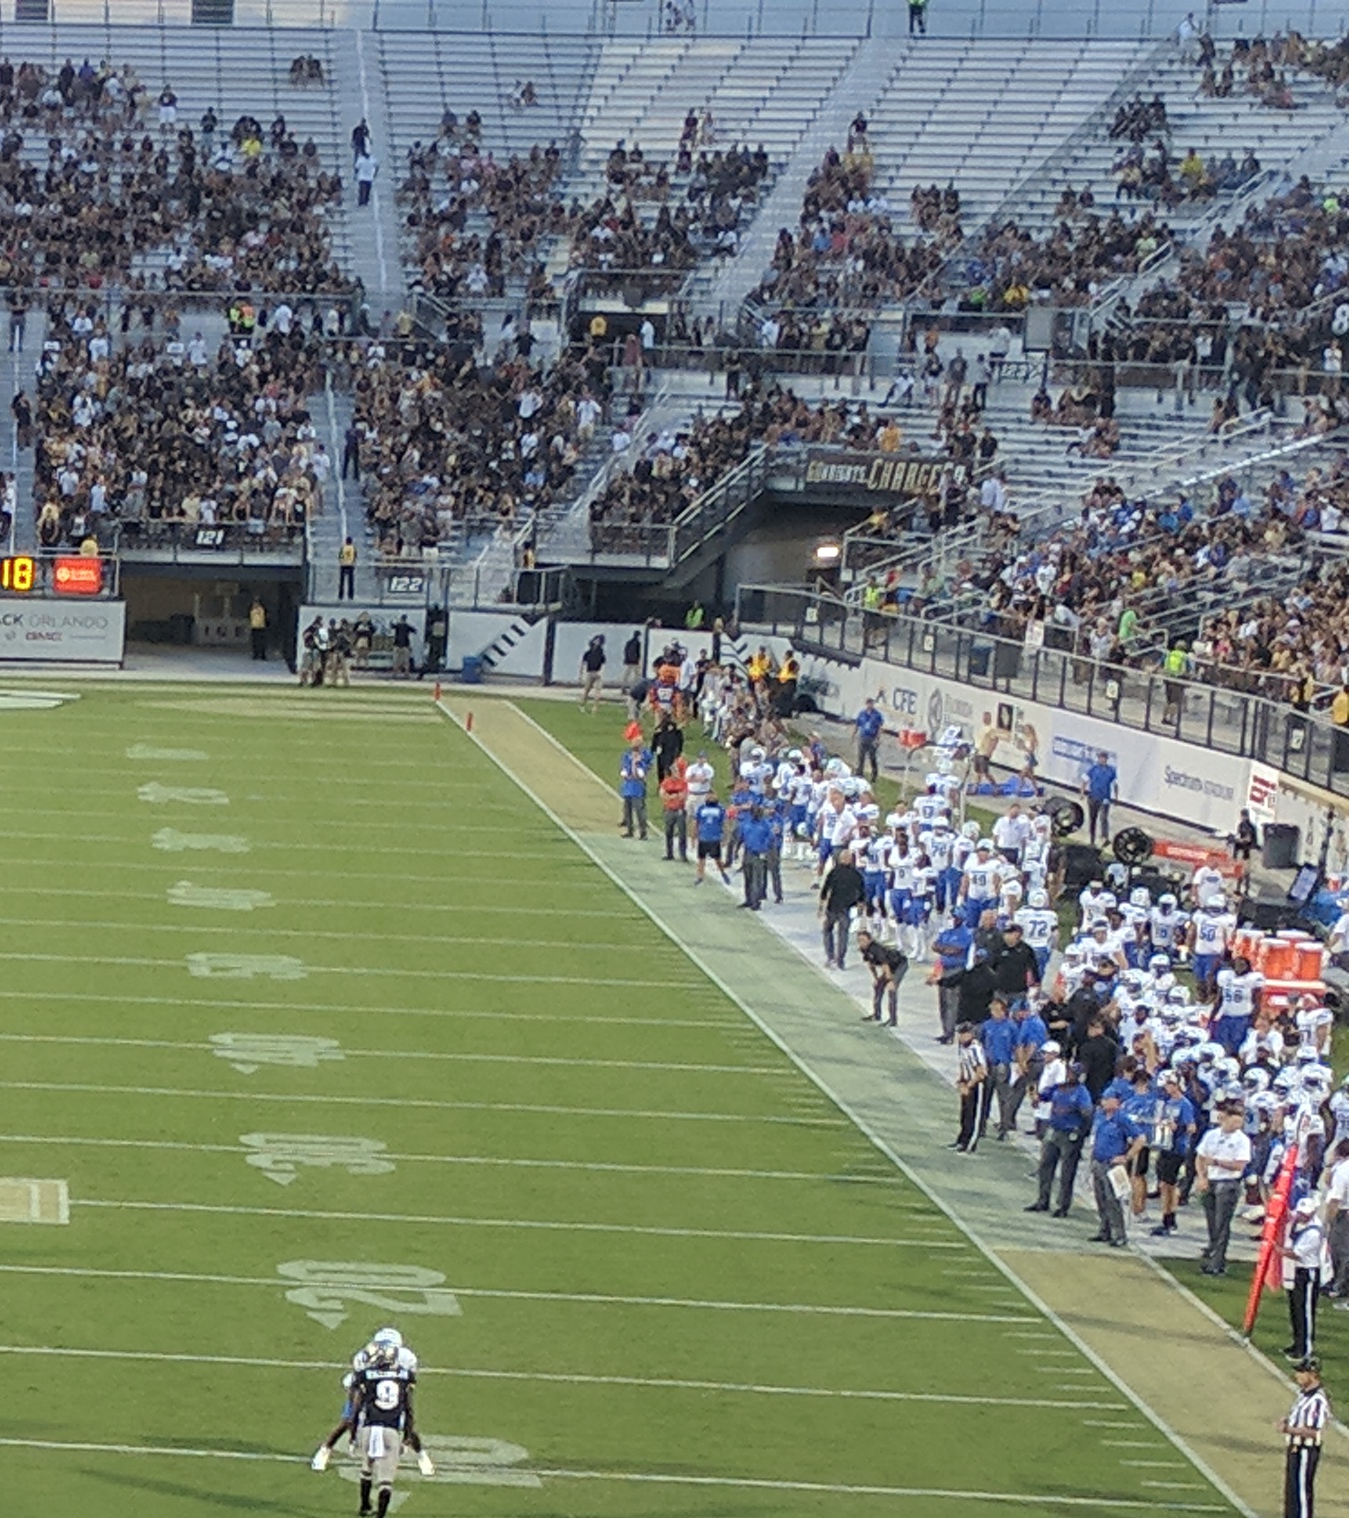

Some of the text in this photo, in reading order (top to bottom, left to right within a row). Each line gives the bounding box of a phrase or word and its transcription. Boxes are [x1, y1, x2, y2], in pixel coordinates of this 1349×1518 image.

[195, 529, 224, 545] 121
[2, 557, 34, 591] 18
[390, 577, 423, 592] 122
[28, 613, 109, 629] ORLANDO
[892, 687, 918, 715] CFE
[1028, 919, 1049, 937] 72
[374, 1379, 399, 1411] 9
